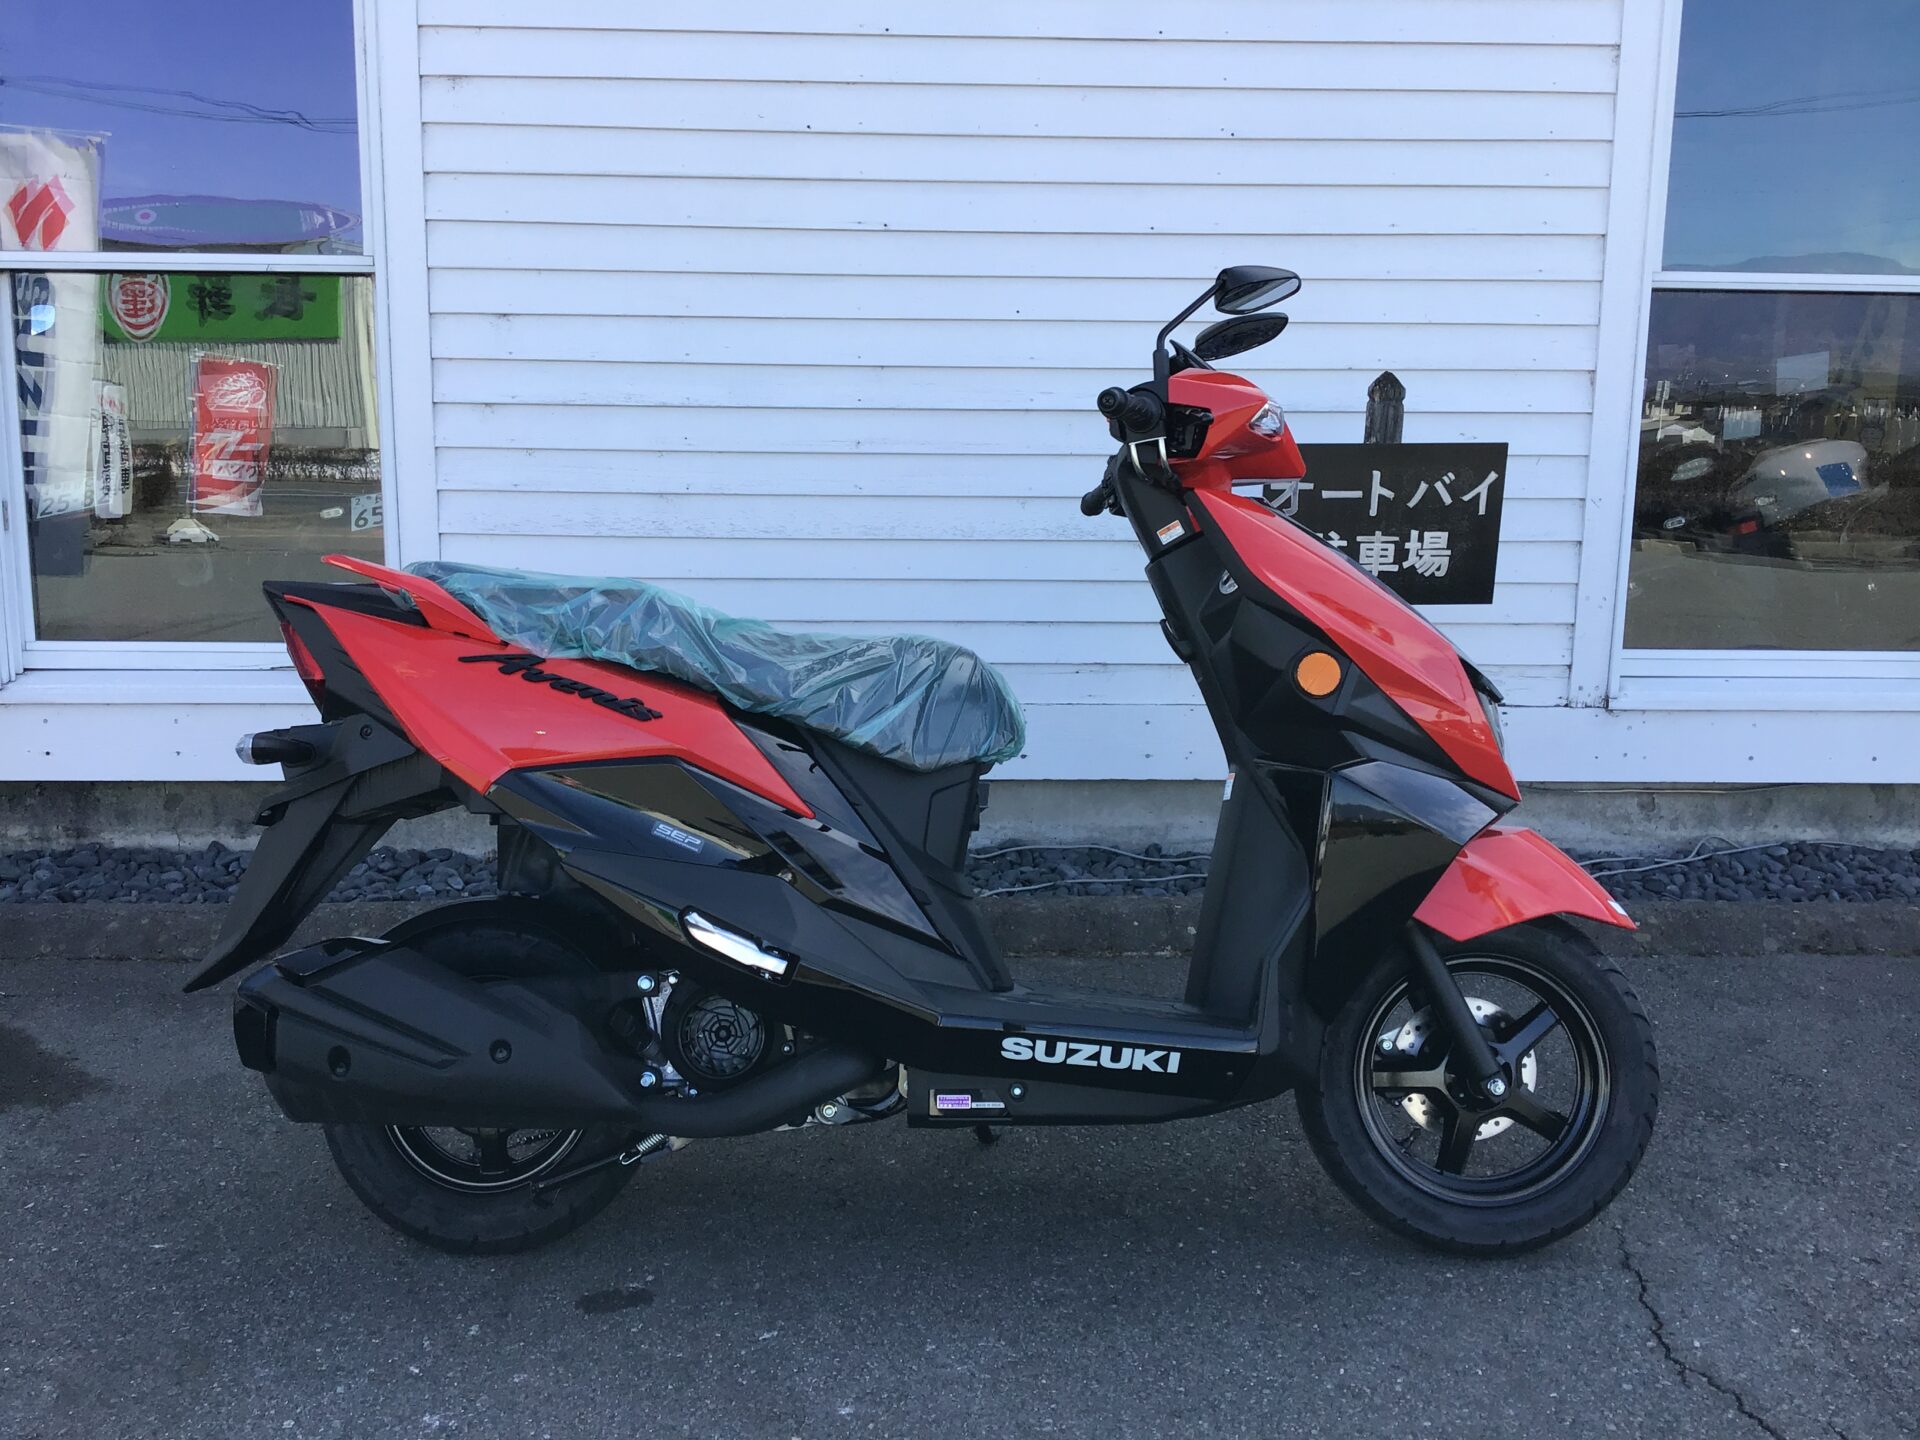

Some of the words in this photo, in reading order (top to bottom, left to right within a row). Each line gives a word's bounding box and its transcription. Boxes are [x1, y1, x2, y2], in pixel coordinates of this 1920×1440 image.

[1269, 470, 1499, 516] オートバイ
[1317, 529, 1452, 578] 車場
[655, 823, 702, 845] SEP
[1000, 1036, 1181, 1074] SUZUKI
